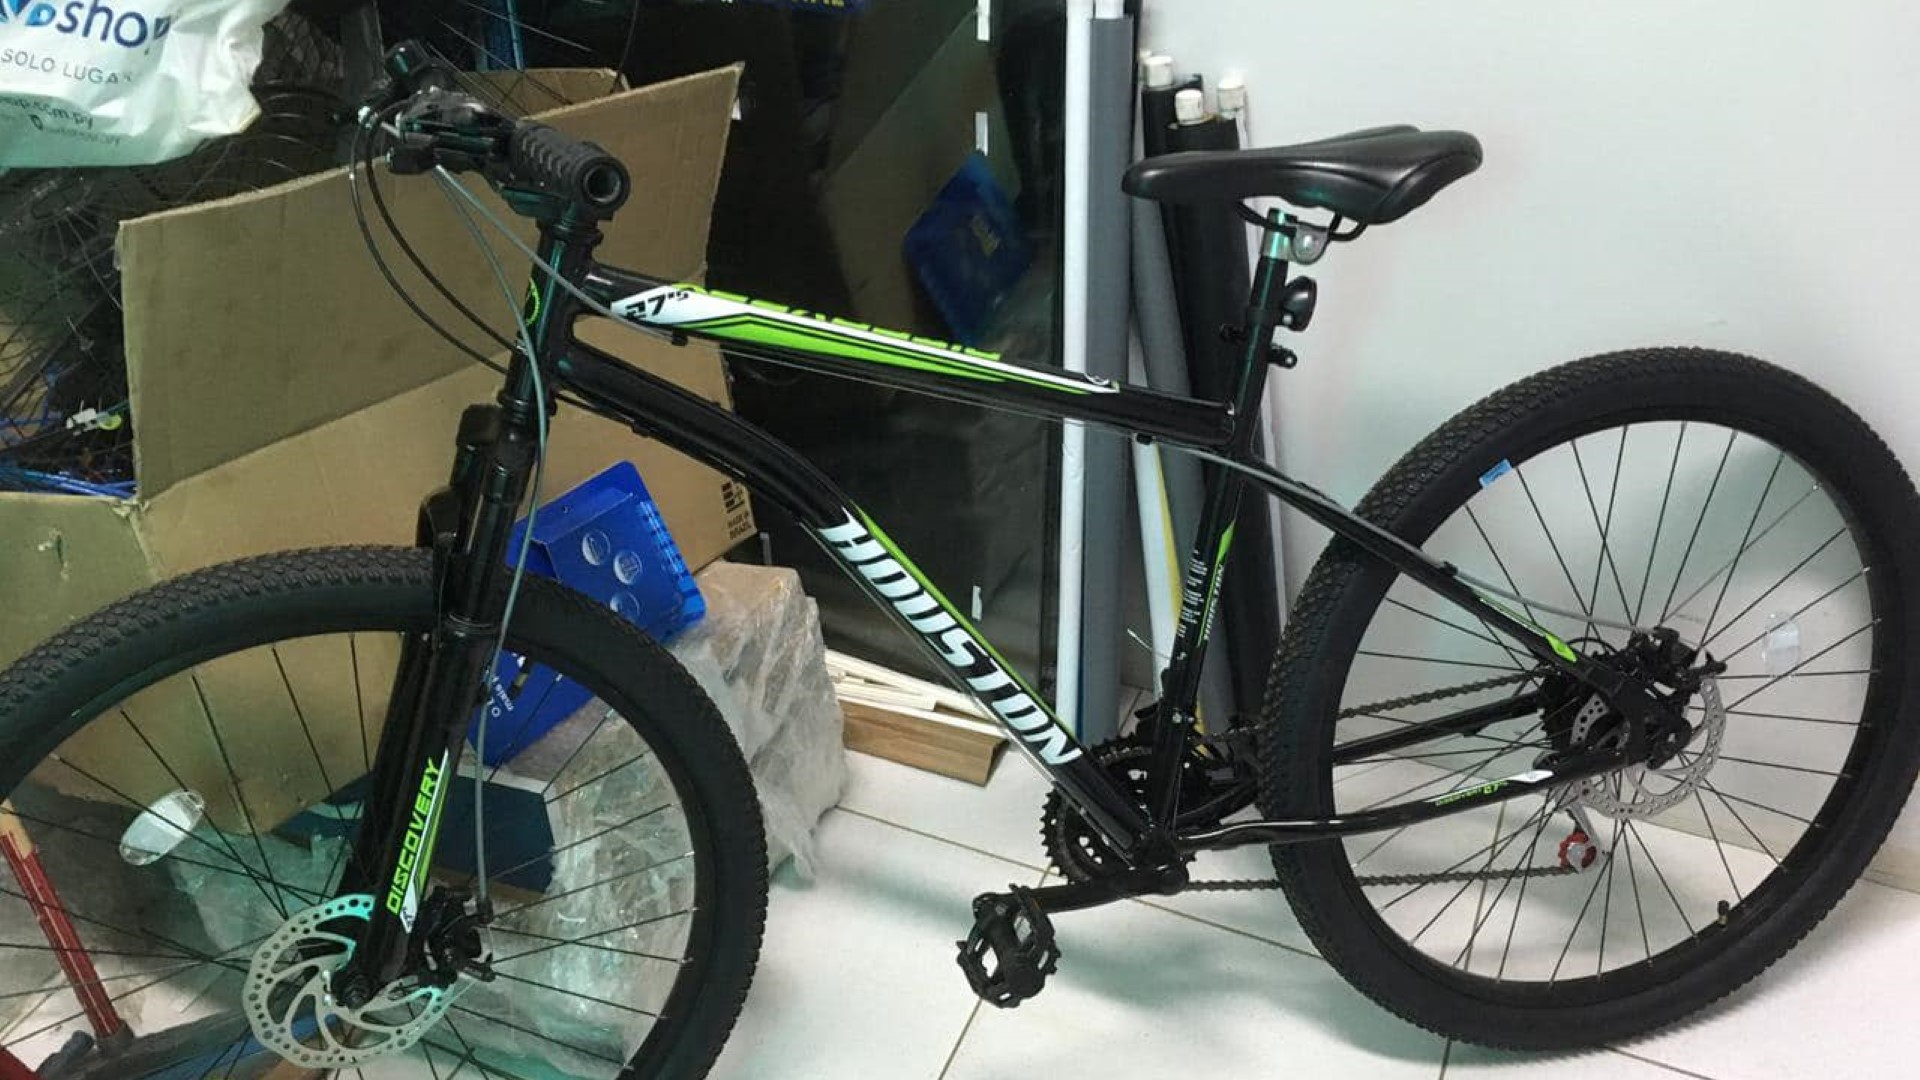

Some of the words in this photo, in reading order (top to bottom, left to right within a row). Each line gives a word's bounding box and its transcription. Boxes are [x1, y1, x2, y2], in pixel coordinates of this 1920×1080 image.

[1, 50, 56, 73] SOLO
[816, 506, 1083, 765] HOUSTON
[386, 757, 439, 915] DISCOVERY
